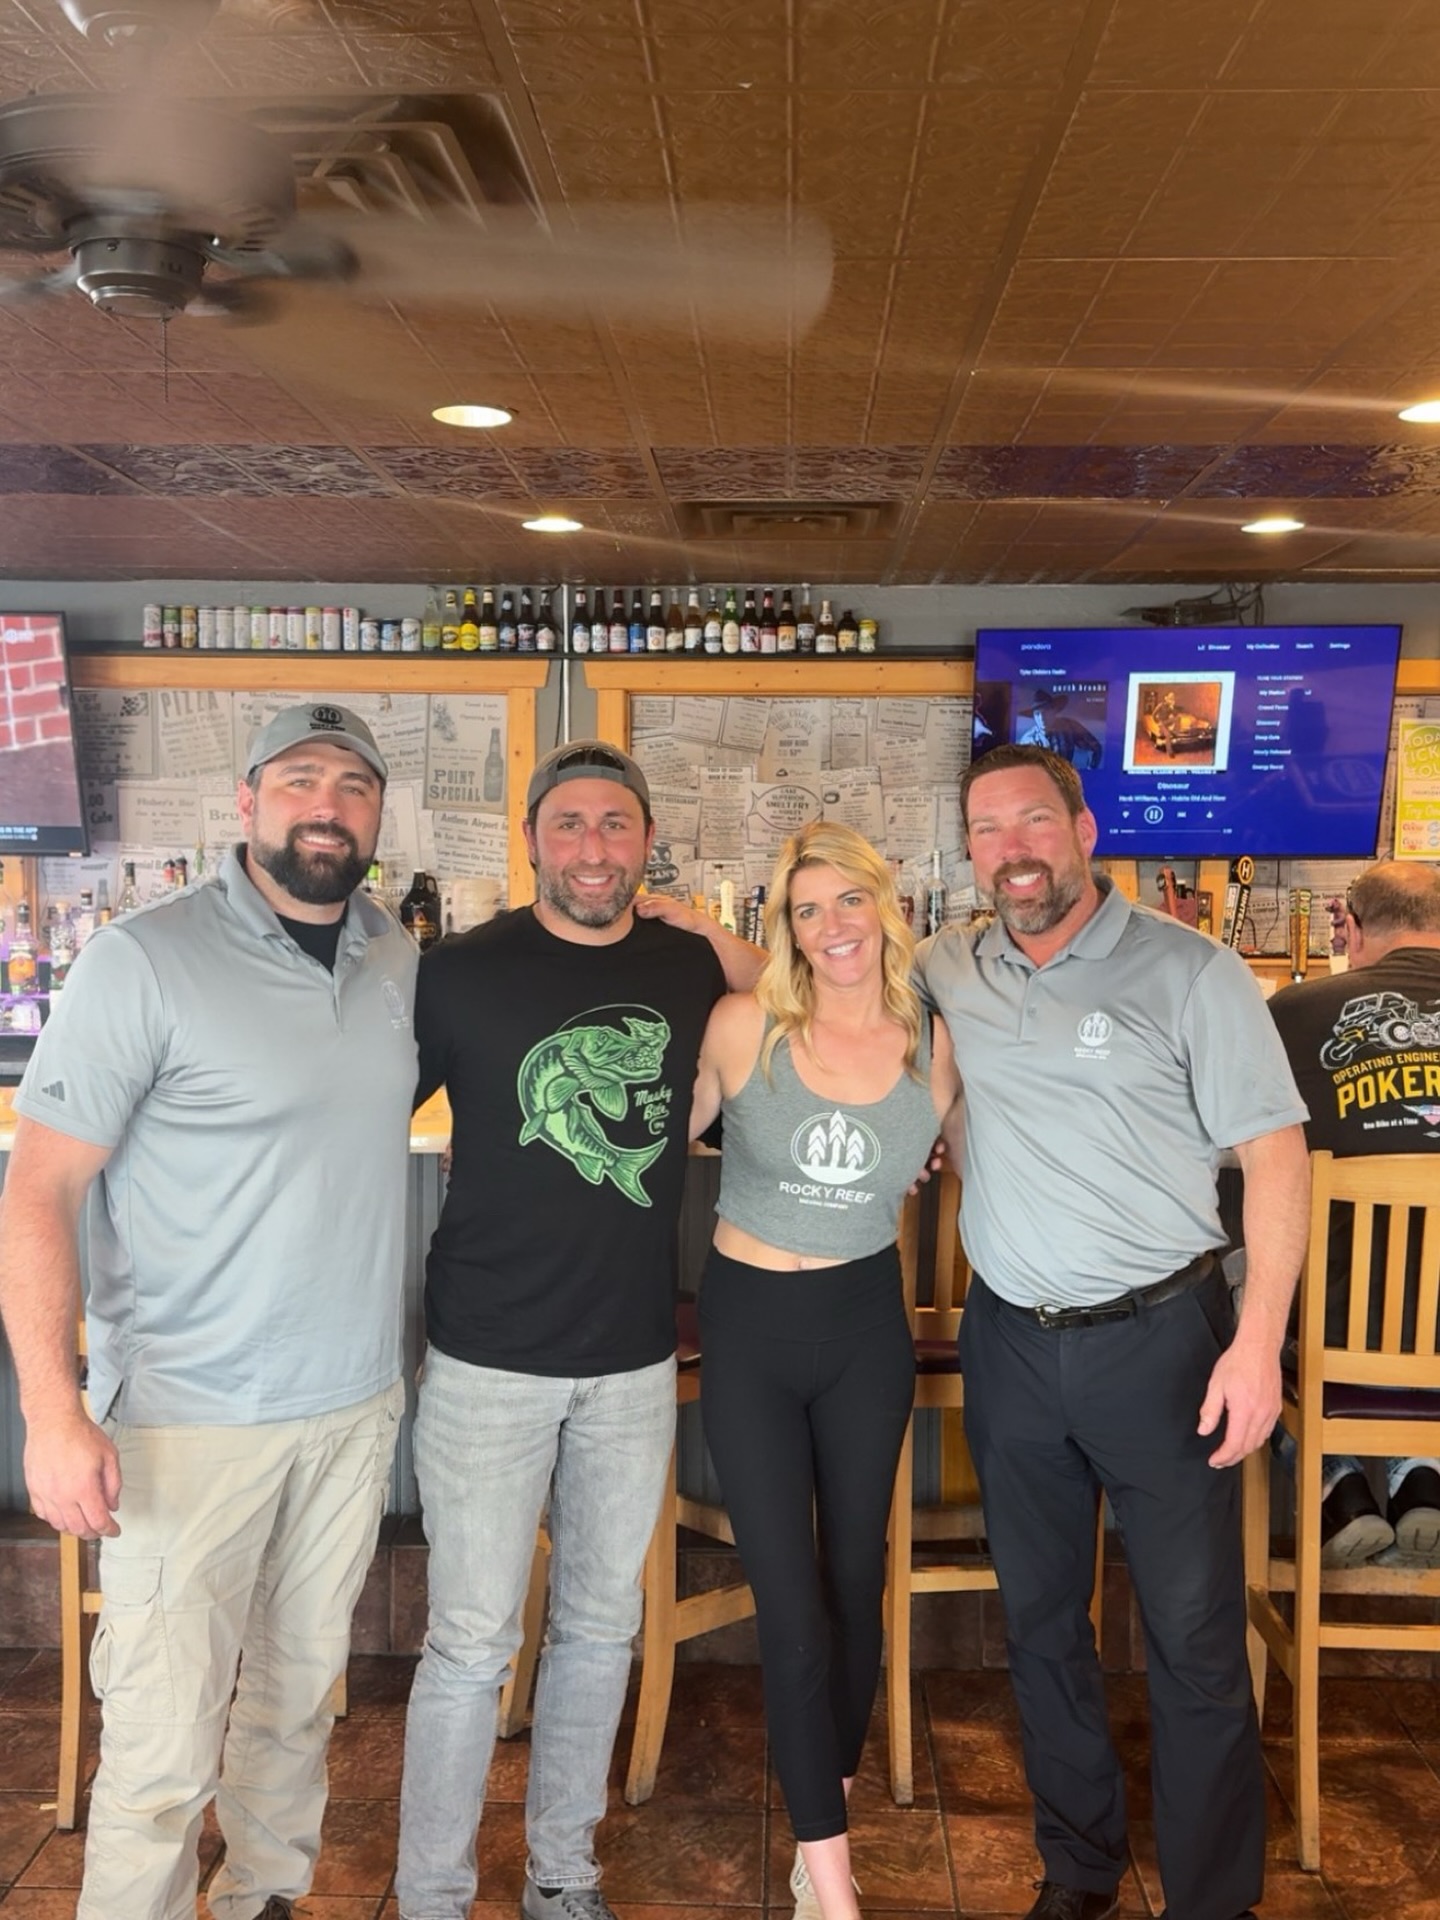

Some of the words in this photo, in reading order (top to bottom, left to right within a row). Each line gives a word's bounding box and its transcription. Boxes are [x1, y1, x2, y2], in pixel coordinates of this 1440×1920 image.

[1021, 643, 1051, 651] pandora
[160, 691, 220, 718] PIZZA
[434, 769, 475, 785] POINT
[1157, 782, 1190, 790] Dinosaur
[429, 784, 481, 802] SPECIAL
[1332, 1055, 1394, 1085] OPERATING
[1336, 1064, 1440, 1119] POKER
[779, 1181, 834, 1199] ROCKY
[834, 1188, 876, 1204] REEF
